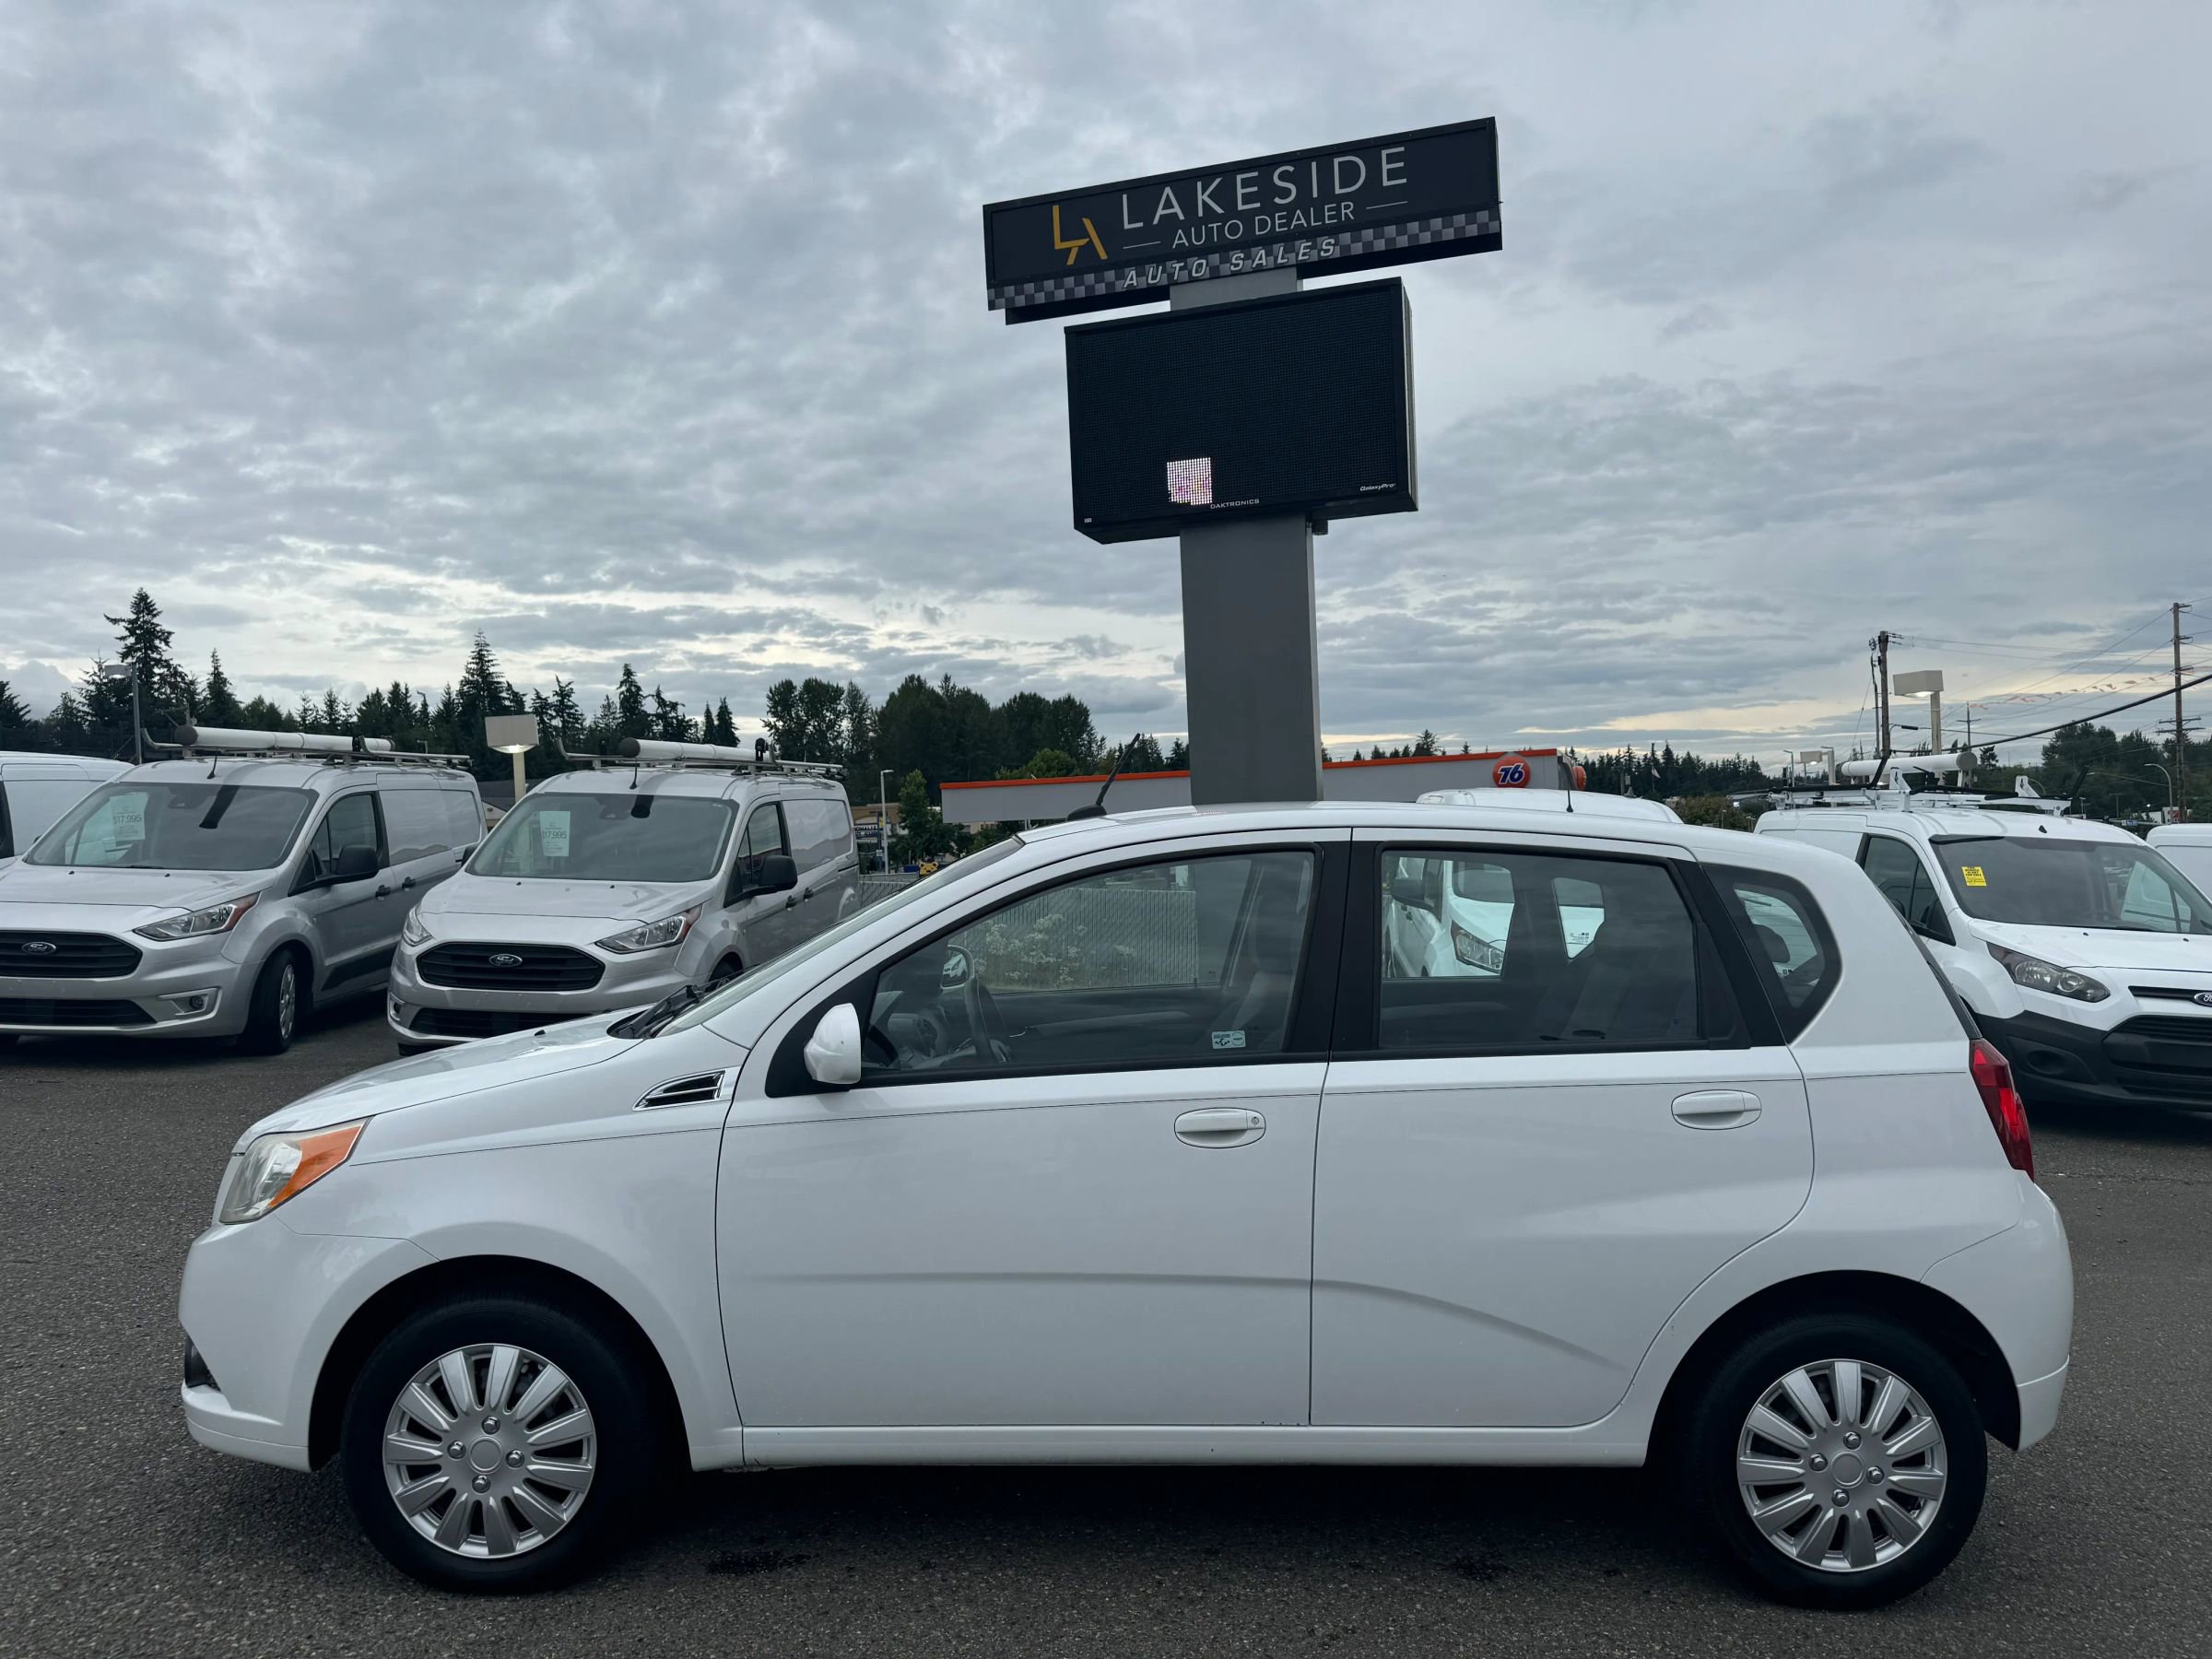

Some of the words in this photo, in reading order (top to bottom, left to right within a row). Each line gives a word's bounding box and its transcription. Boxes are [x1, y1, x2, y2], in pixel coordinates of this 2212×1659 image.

[1122, 147, 1407, 229] LAKESIDE
[1053, 205, 1108, 265] LA
[1172, 219, 1243, 249] AUTO
[1254, 201, 1355, 235] DEALER
[1124, 259, 1207, 288] AUTO
[1230, 238, 1335, 271] SALES
[1210, 499, 1260, 510] DAKTRONICS
[1498, 763, 1525, 783] 76
